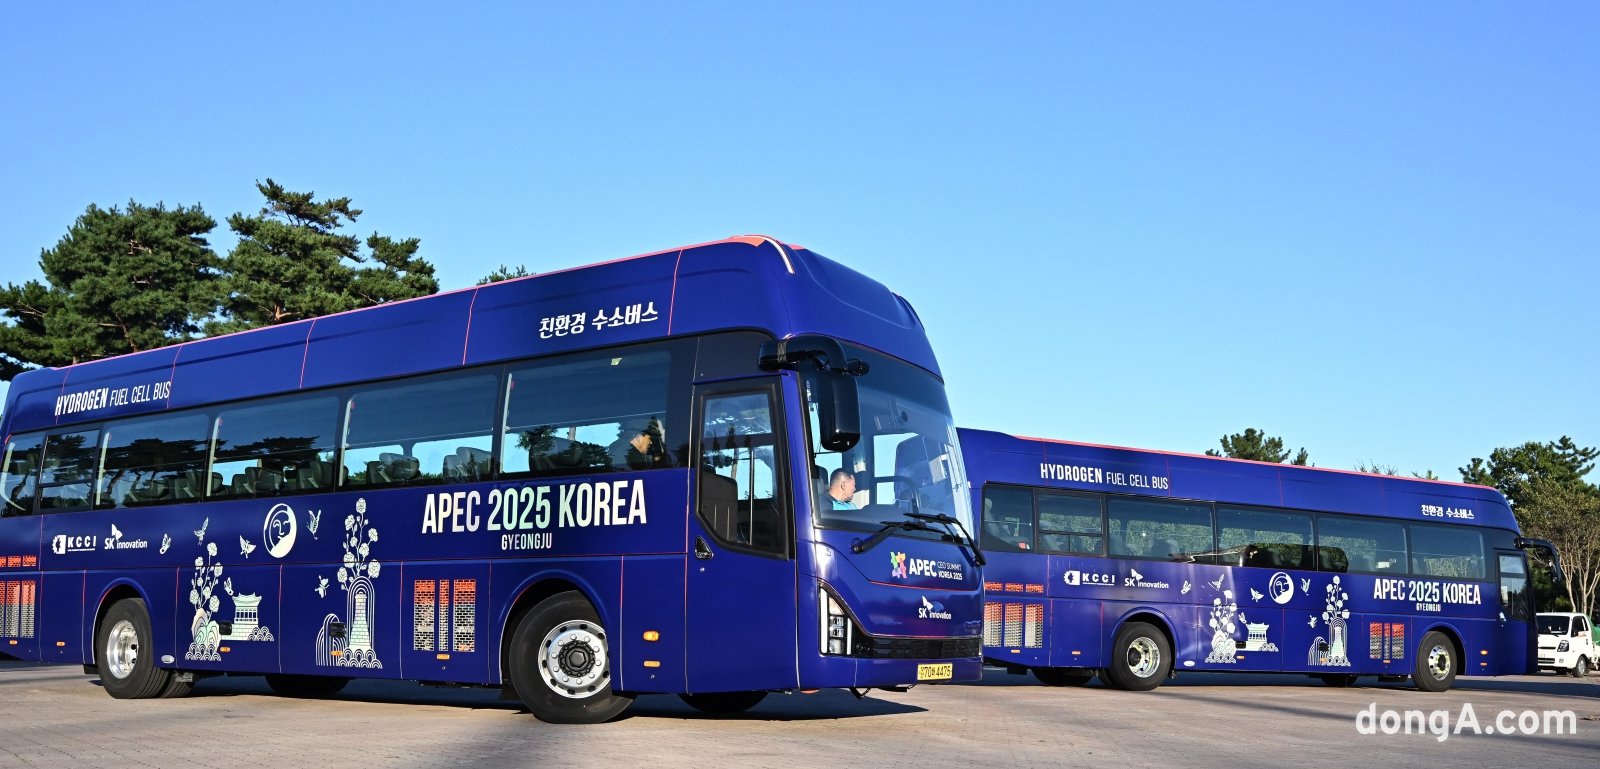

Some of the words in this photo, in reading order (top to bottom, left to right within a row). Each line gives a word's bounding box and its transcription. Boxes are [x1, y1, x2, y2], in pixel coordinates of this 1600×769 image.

[539, 312, 586, 339] 친환경
[591, 301, 658, 331] 수소버스
[54, 387, 109, 416] HYDROGEN
[109, 388, 129, 407] FUEL
[131, 384, 150, 403] CELL
[153, 381, 171, 401] BUS
[1040, 463, 1102, 484] HYDROGEN
[1106, 471, 1127, 486] FUEL
[1129, 474, 1150, 488] CELL
[1151, 476, 1169, 490] BUS
[421, 490, 481, 534] APEC
[487, 486, 551, 531] 2025
[558, 479, 647, 528] KOREA
[1421, 504, 1444, 518] 친환경
[1445, 507, 1475, 520] 수소버스
[67, 535, 97, 548] KCCI
[104, 537, 116, 550] SK
[116, 538, 148, 550] innovation
[501, 532, 553, 551] GYEONGJU
[908, 558, 937, 577] APEC
[937, 560, 947, 570] CEO
[1082, 572, 1115, 583] KCCI
[1124, 577, 1136, 587] SK
[1137, 580, 1169, 589] innovation
[1373, 578, 1406, 600] APEC
[1408, 580, 1440, 603] 2025
[1442, 582, 1481, 605] KOREA
[918, 607, 928, 619] SK
[929, 611, 952, 620] innovation
[1416, 602, 1441, 612] GYEONGJU
